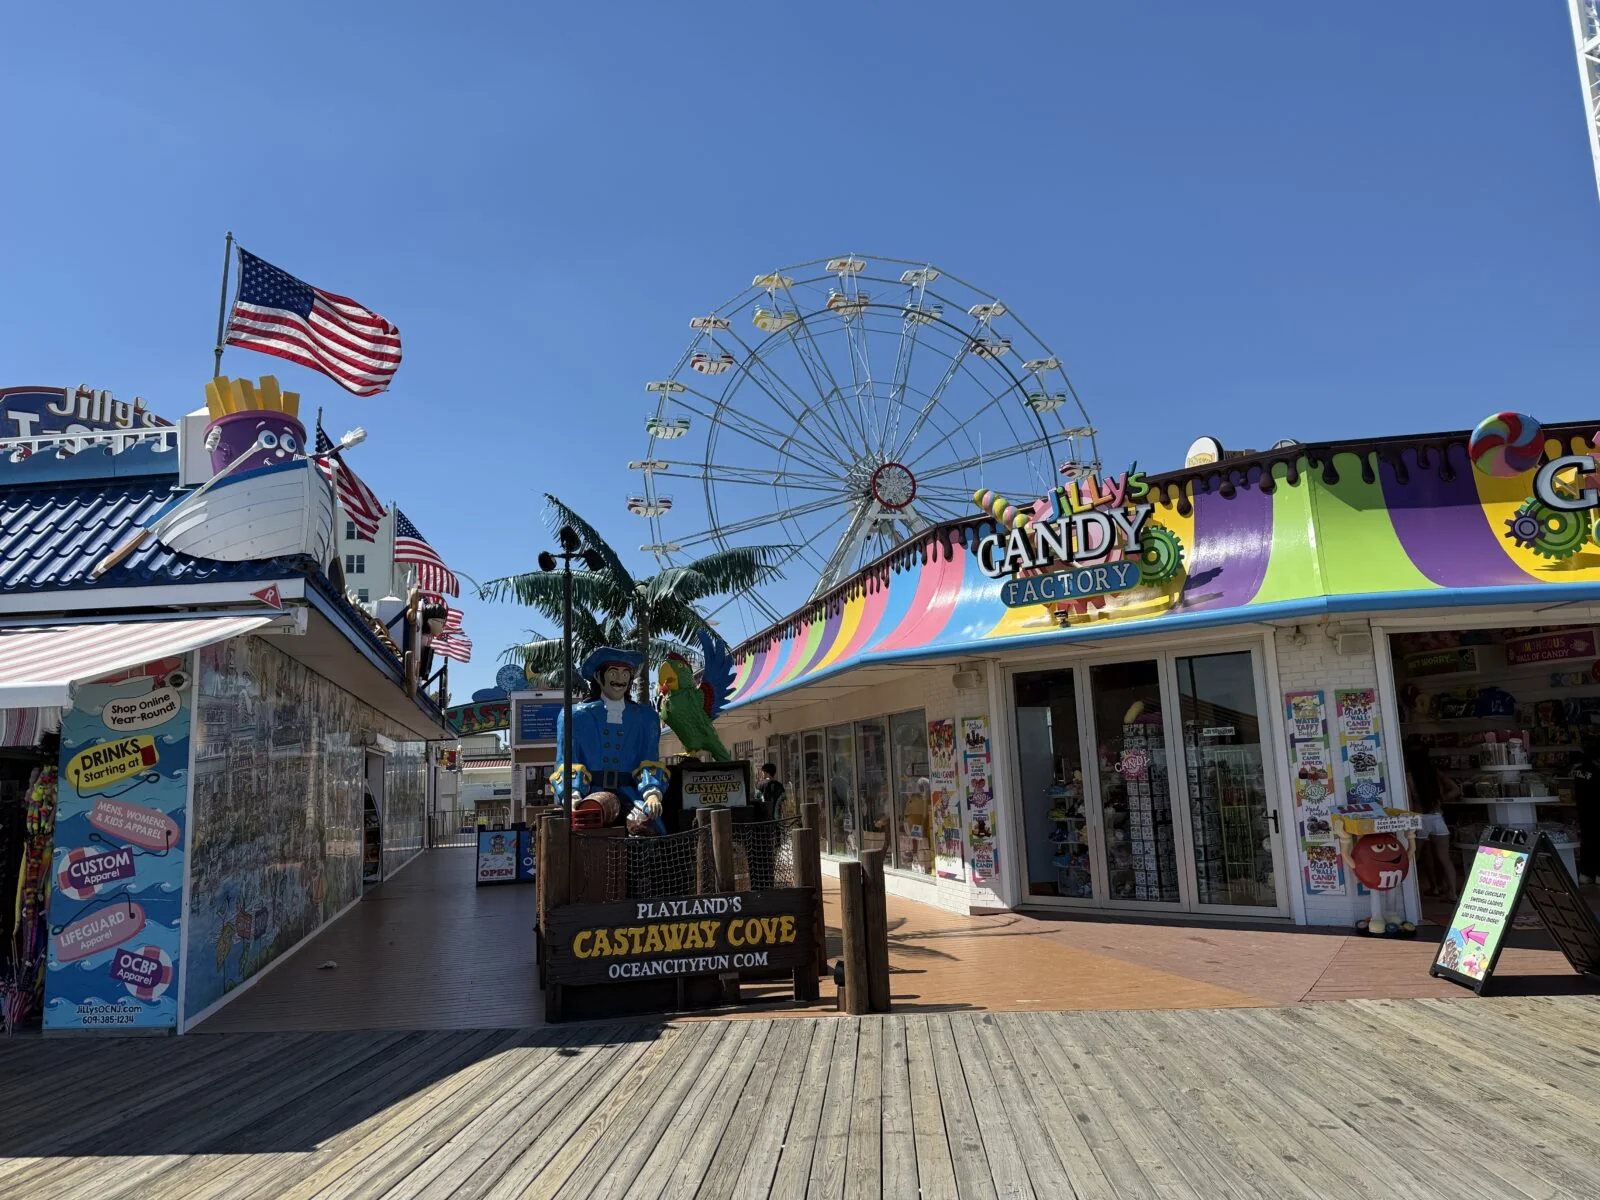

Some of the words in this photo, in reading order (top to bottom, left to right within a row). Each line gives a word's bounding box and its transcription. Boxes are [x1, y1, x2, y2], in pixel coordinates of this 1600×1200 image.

[48, 384, 156, 429] Jilly's
[978, 504, 1152, 578] CANDY
[1008, 562, 1131, 605] FACTORY
[1541, 648, 1570, 659] CANDY
[111, 704, 137, 714] Shop
[139, 693, 171, 709] Online
[111, 702, 177, 725] Year-Round!
[80, 739, 141, 771] DRINKS
[1115, 755, 1150, 773] CANDY
[84, 762, 127, 782] Starting
[128, 757, 140, 769] at
[693, 774, 735, 782] PLAYLAND'S
[685, 782, 741, 794] CASTAWAY
[699, 793, 728, 804] COVE
[96, 812, 103, 822] &
[104, 814, 124, 828] KIDS
[124, 822, 162, 839] APPAREL
[98, 801, 124, 817] MENS,
[126, 810, 167, 830] WOMENS,
[70, 852, 130, 878] CUSTOM
[480, 868, 513, 878] OPEN
[84, 868, 120, 885] Apparel
[637, 896, 742, 919] PLAYLAND'S
[60, 911, 125, 947] LIFEGUARD
[573, 920, 721, 959] CASTAWAY
[727, 915, 797, 947] COVE
[80, 931, 113, 950] Apparel
[120, 954, 158, 975] OCBP
[117, 968, 153, 985] Apparel
[82, 1015, 135, 1024] 609-385-1234
